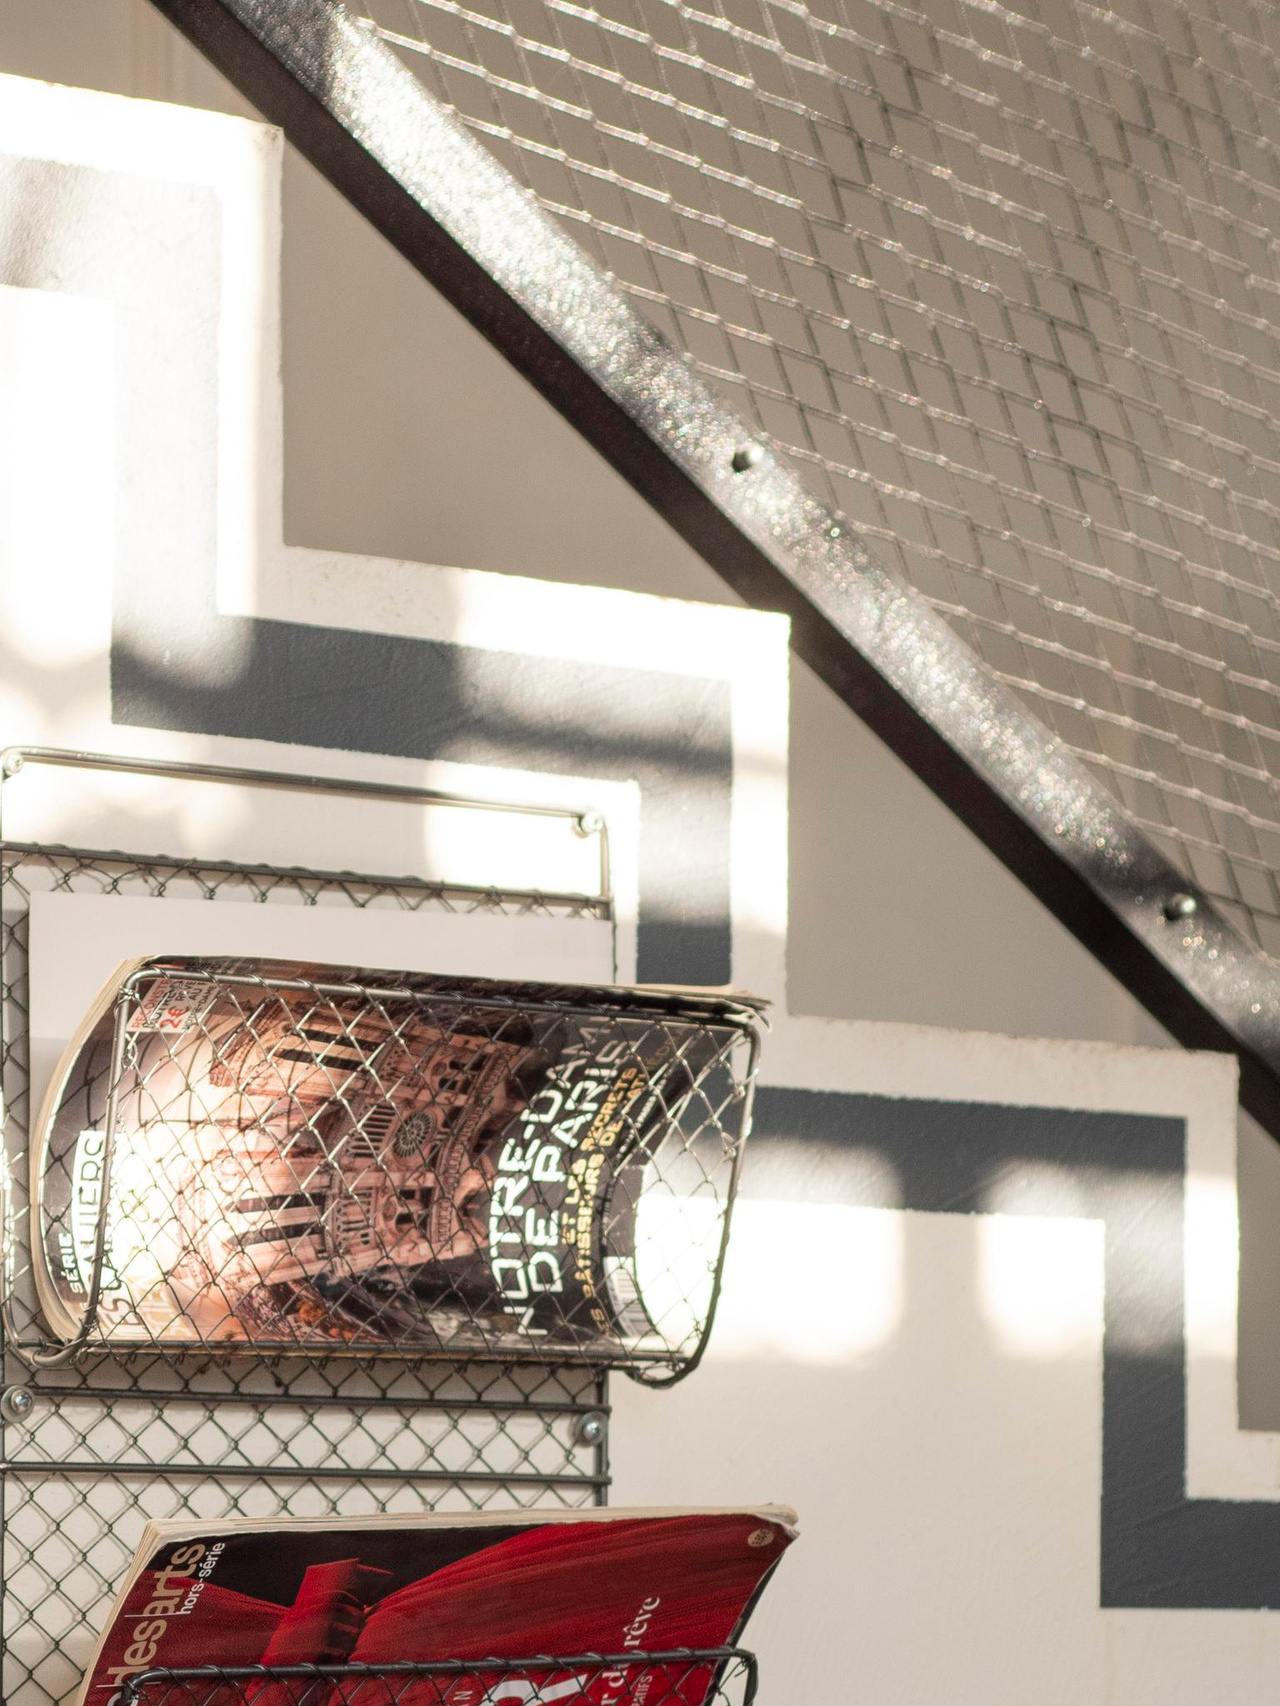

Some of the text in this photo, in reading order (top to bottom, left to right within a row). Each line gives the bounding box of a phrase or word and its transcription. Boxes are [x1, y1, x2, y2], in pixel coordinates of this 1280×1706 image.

[159, 1005, 191, 1028] 2€
[531, 1039, 640, 1183] PARIS
[579, 1067, 638, 1152] SECRETS
[598, 1118, 624, 1147] DE
[489, 1016, 612, 1335] NOTRE-DAM
[564, 1158, 588, 1205] LES
[524, 1207, 564, 1293] DE
[560, 1211, 577, 1246] ET
[58, 1231, 84, 1294] SÉRIE
[176, 1542, 226, 1614] hors-série
[622, 1596, 661, 1648] rêve
